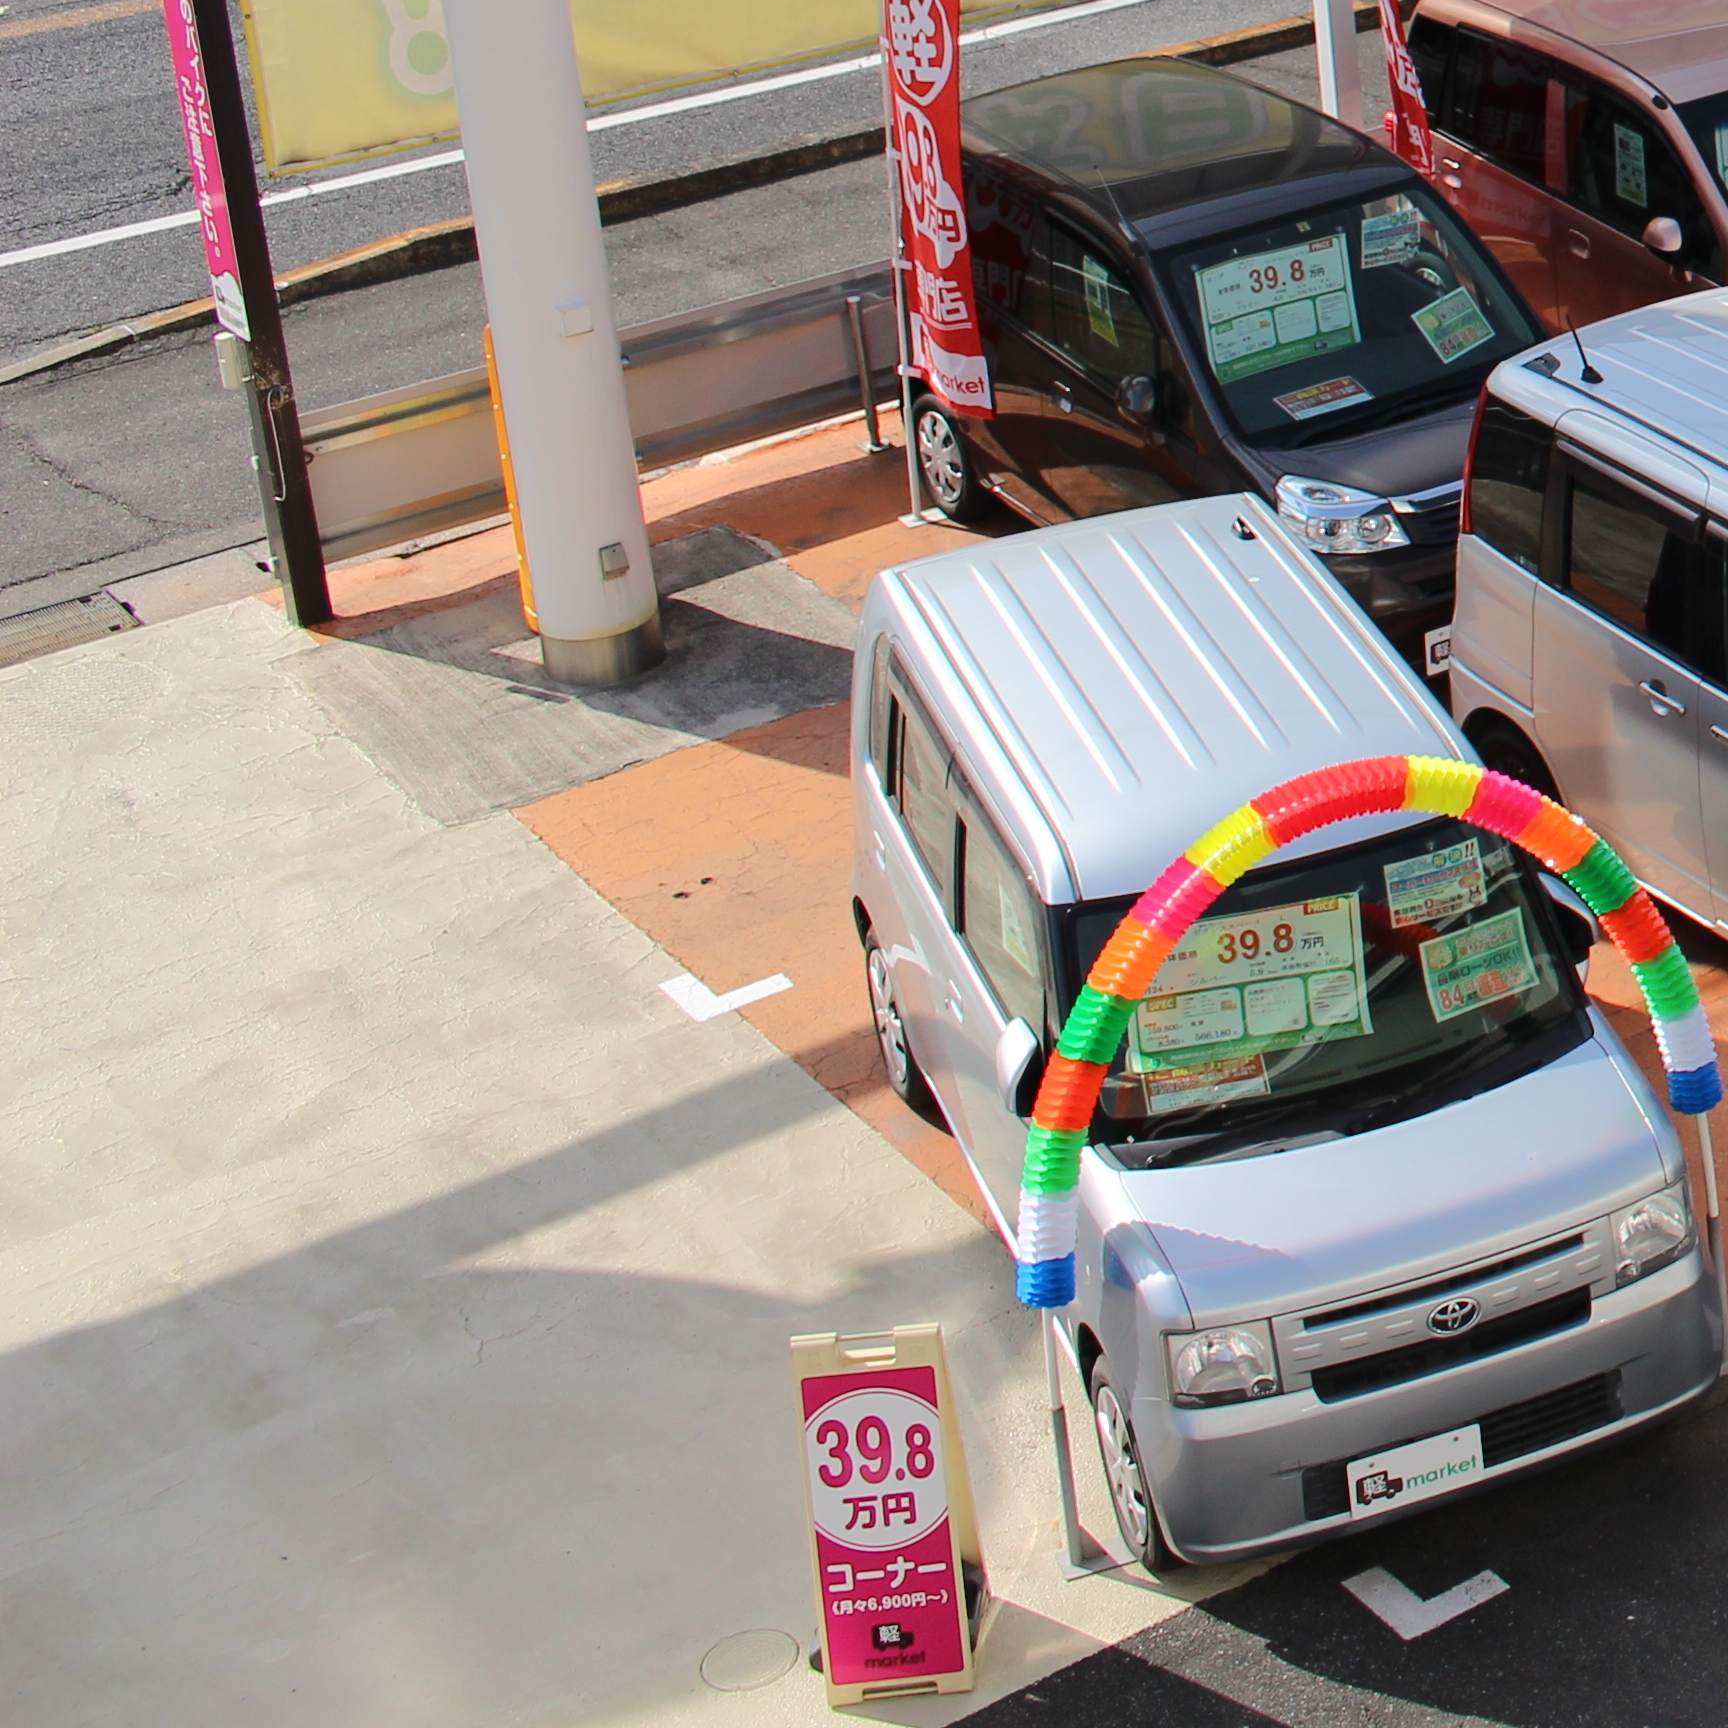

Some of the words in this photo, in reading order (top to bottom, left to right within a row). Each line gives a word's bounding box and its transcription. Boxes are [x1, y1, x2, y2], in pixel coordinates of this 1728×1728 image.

[1248, 259, 1306, 294] 39.8
[1309, 267, 1326, 279] 万円
[1306, 901, 1335, 914] PRICE
[1167, 949, 1198, 963] 体価格
[1216, 922, 1296, 965] 39.8
[1300, 935, 1326, 952] 万円
[1436, 946, 1522, 987] 長期ローンOK!!
[1147, 999, 1176, 1012] SPEC
[816, 1415, 935, 1488] 39.8
[1362, 1472, 1389, 1500] 軽
[1405, 1455, 1480, 1492] market
[842, 1491, 917, 1530] 万円
[826, 1556, 948, 1593] コーナー
[876, 1623, 901, 1644] 軽
[864, 1650, 926, 1670] market
